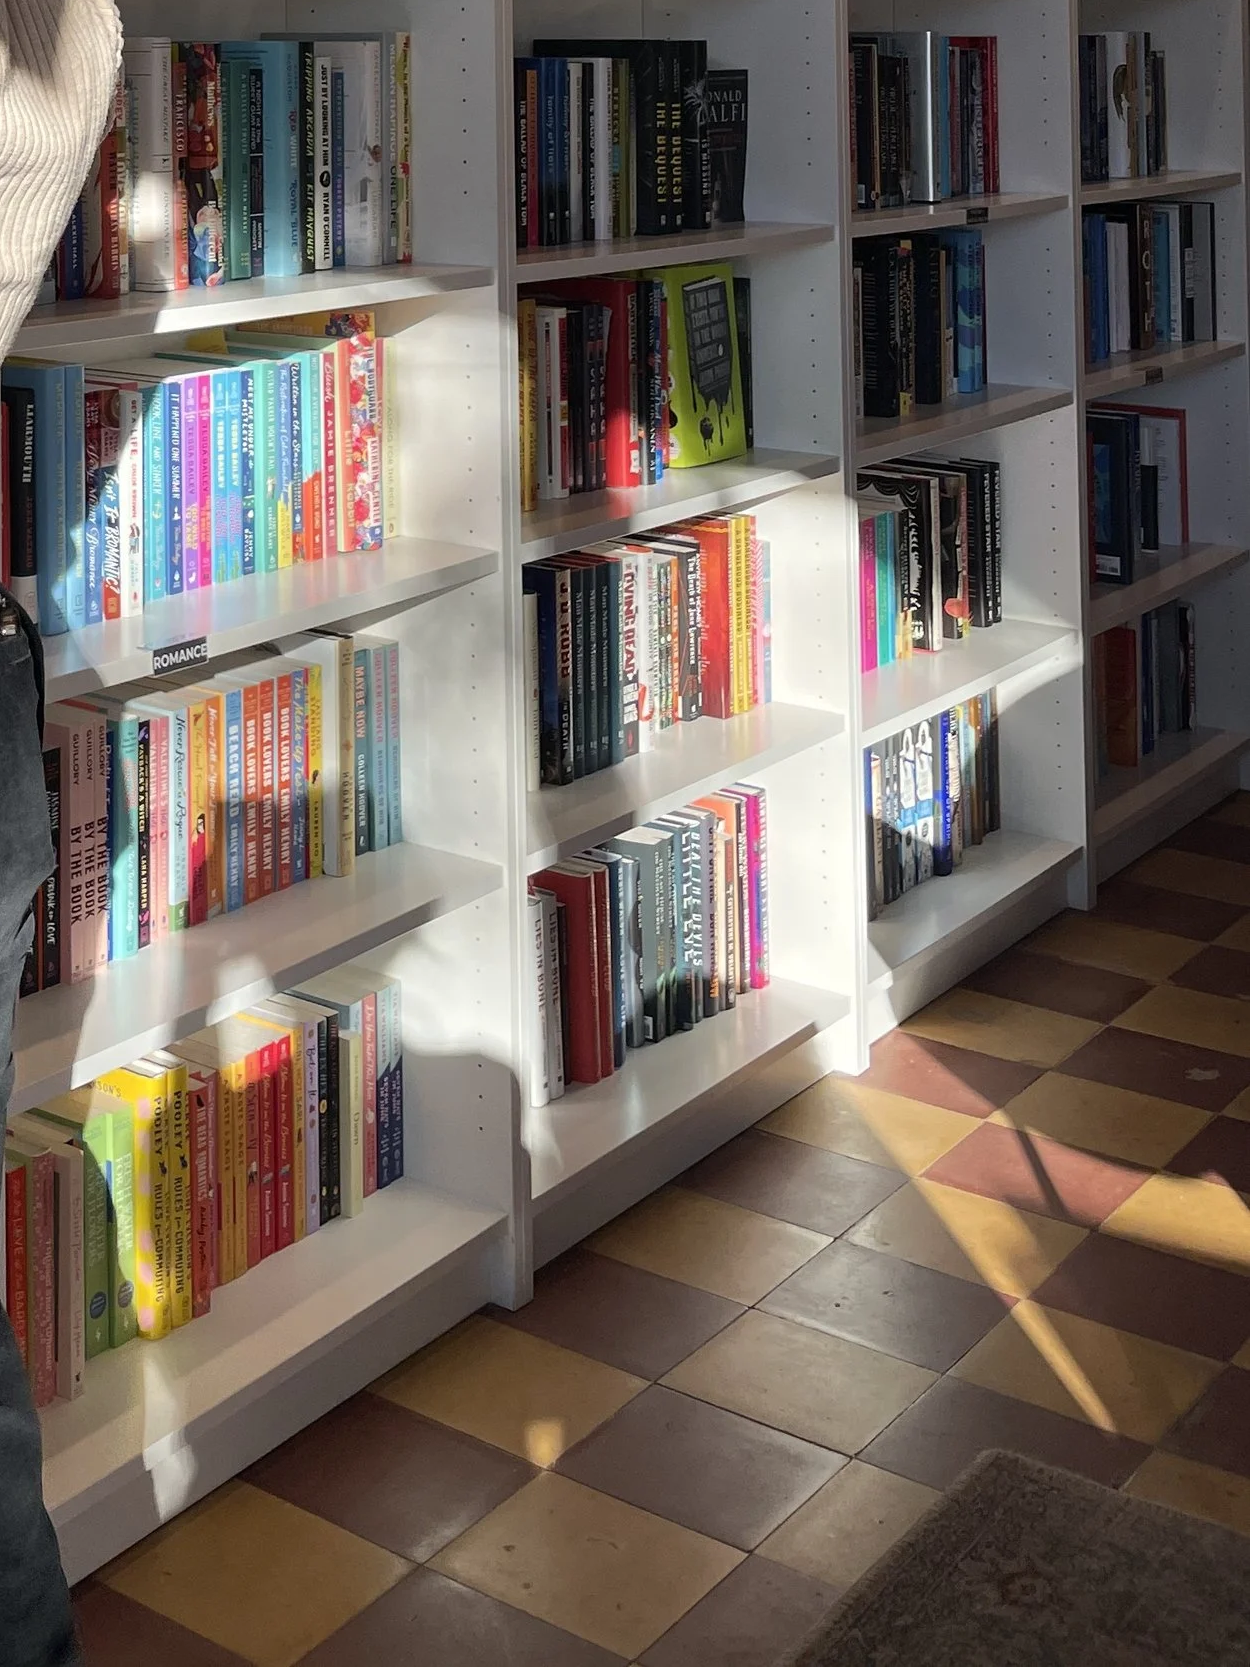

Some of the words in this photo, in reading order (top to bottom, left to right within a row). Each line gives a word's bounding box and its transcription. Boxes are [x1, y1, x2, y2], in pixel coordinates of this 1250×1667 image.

[321, 87, 329, 99] BY
[656, 102, 666, 128] THE
[655, 136, 666, 203] BEQUEST
[322, 192, 330, 214] RYAN
[172, 393, 179, 403] IT
[153, 643, 209, 670] ROMANCE
[281, 707, 289, 739] BOOK
[281, 740, 290, 782] LOVERS
[71, 825, 82, 844] BY
[71, 850, 82, 880] THE
[71, 884, 82, 926] BOOK
